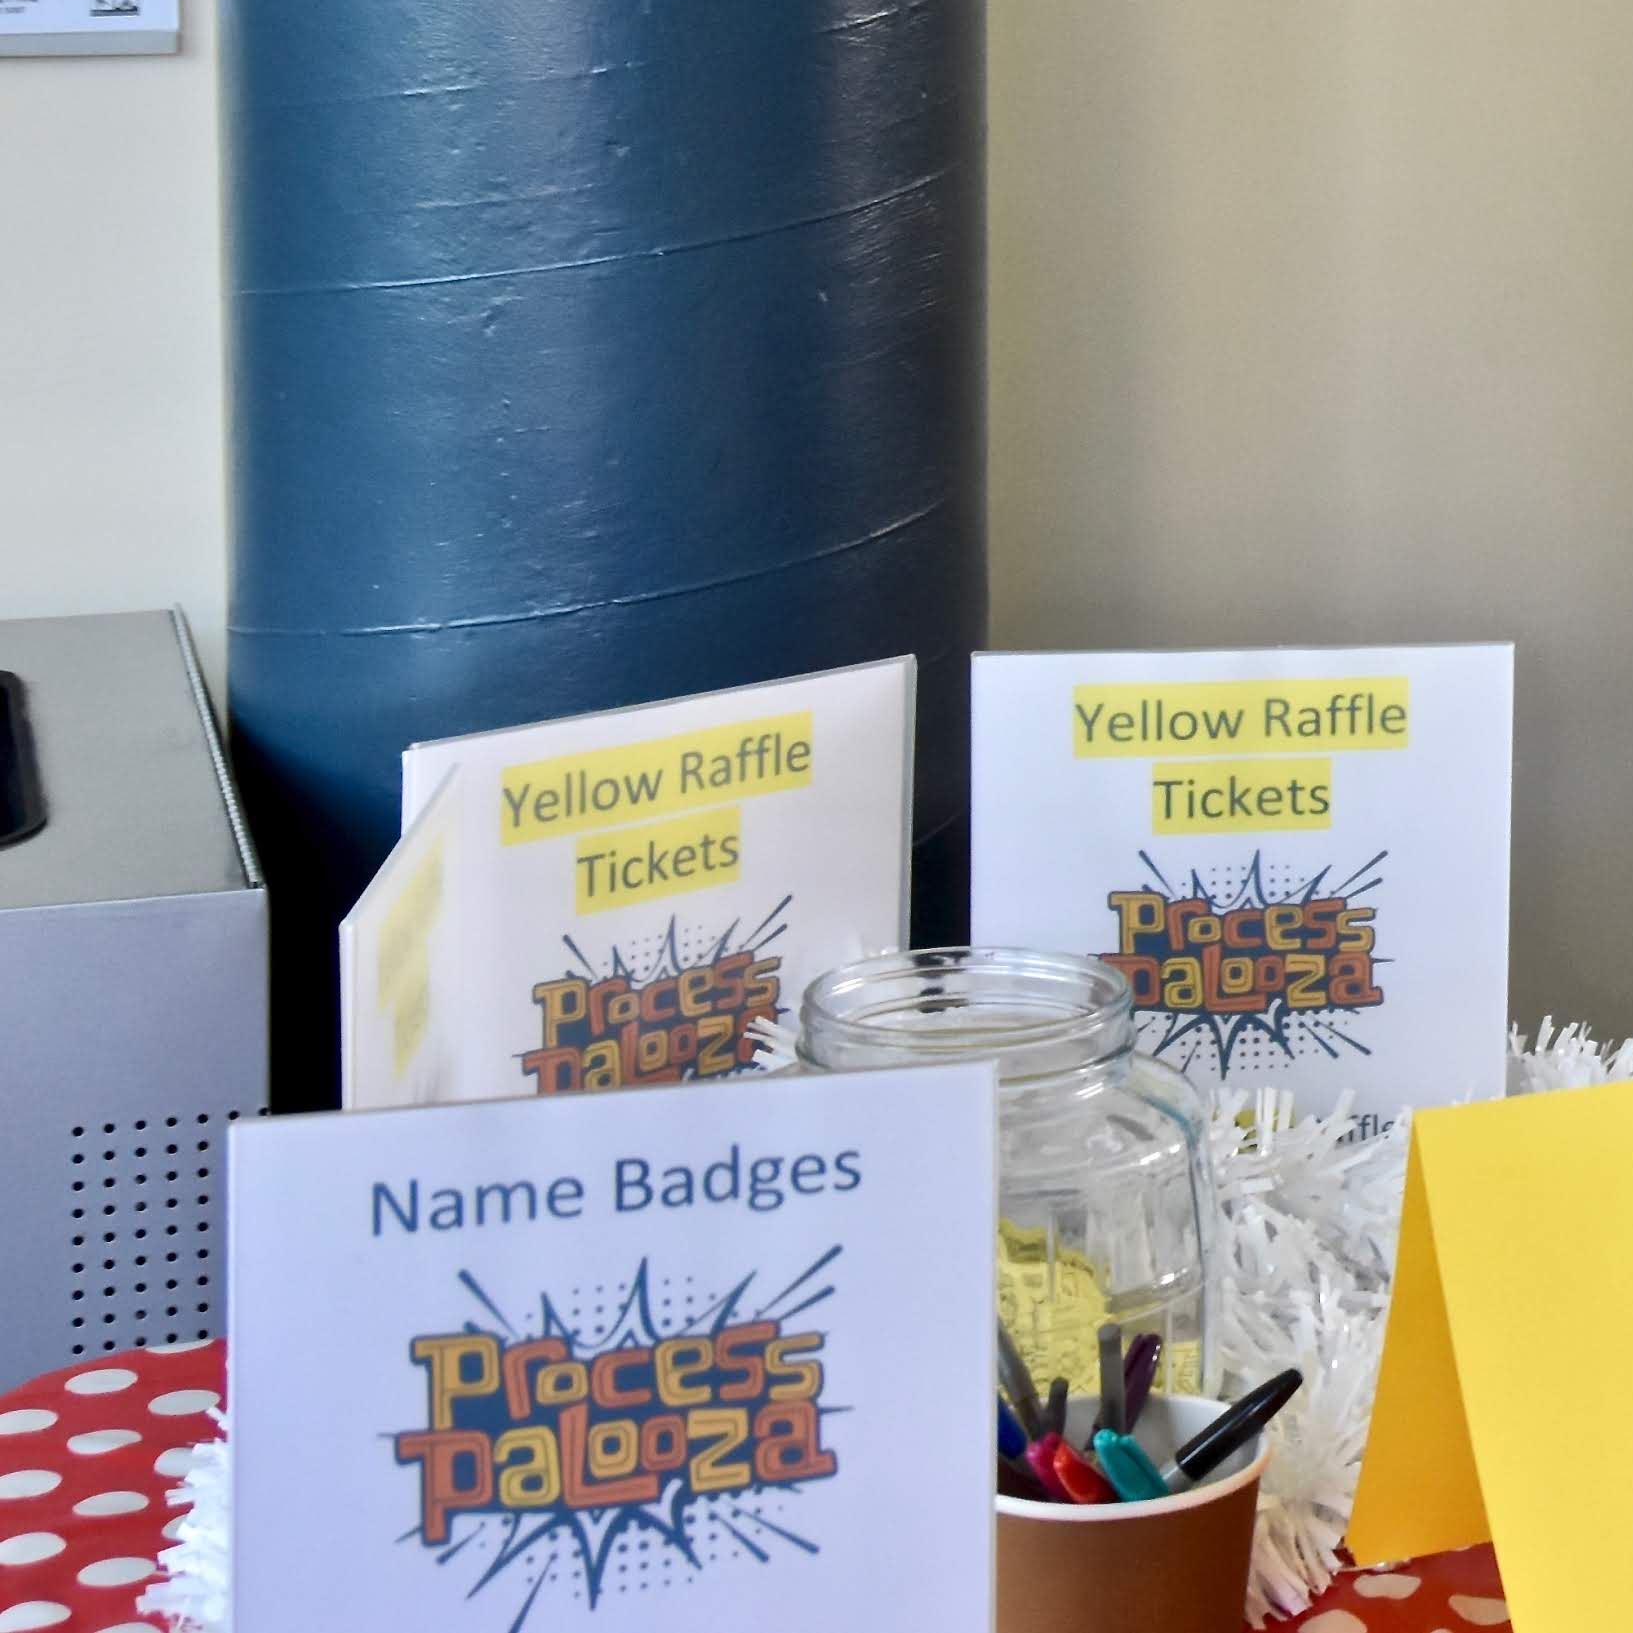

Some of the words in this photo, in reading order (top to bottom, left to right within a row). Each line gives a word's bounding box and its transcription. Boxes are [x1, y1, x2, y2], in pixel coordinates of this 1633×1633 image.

[1075, 699, 1245, 744] Yellow
[1264, 693, 1408, 738] Raffle
[503, 763, 663, 828] Yellow
[680, 732, 811, 795] Raffle
[1153, 775, 1330, 821] Tickets
[577, 830, 740, 899] Tickets
[1108, 890, 1377, 956] Process
[531, 950, 781, 1048] Process
[370, 1171, 587, 1238] Name
[613, 1144, 864, 1214] Badges
[409, 1319, 827, 1433] Process
